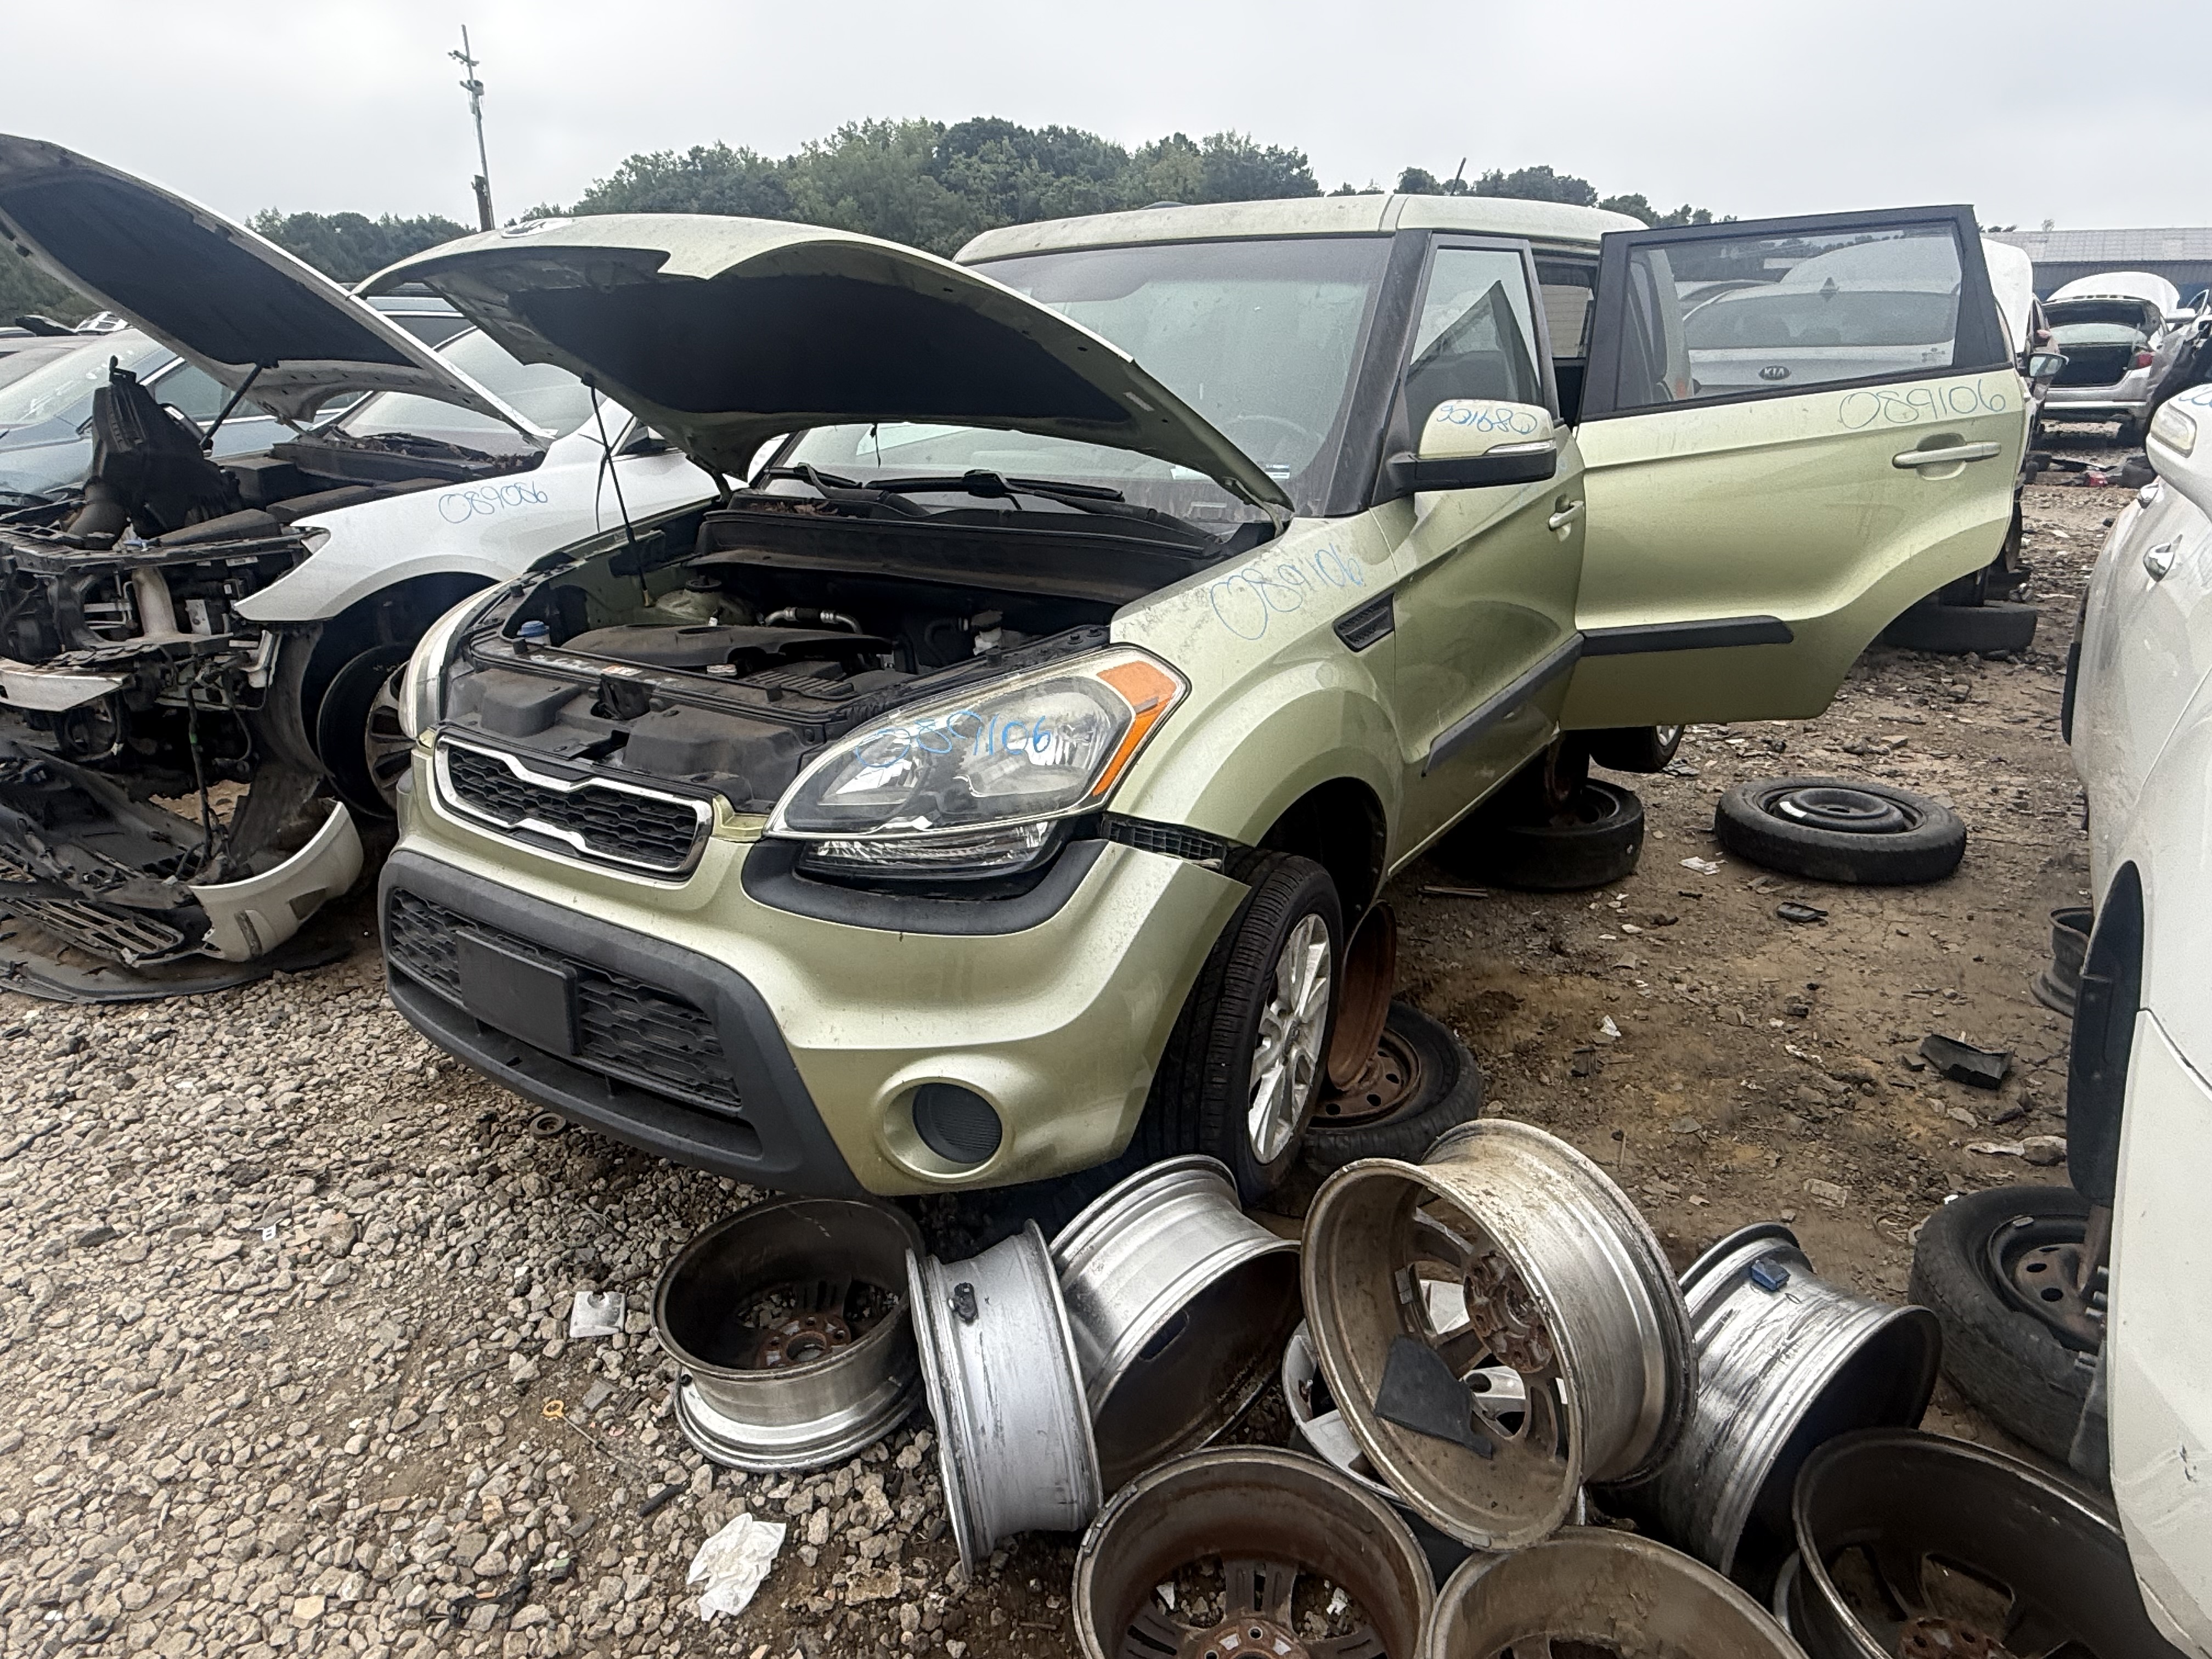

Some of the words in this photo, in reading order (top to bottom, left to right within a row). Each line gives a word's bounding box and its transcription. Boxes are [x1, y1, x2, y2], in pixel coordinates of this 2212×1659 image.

[1839, 379, 2006, 430] 089106
[1210, 542, 1365, 641] 089106
[855, 710, 1051, 768] 089106
